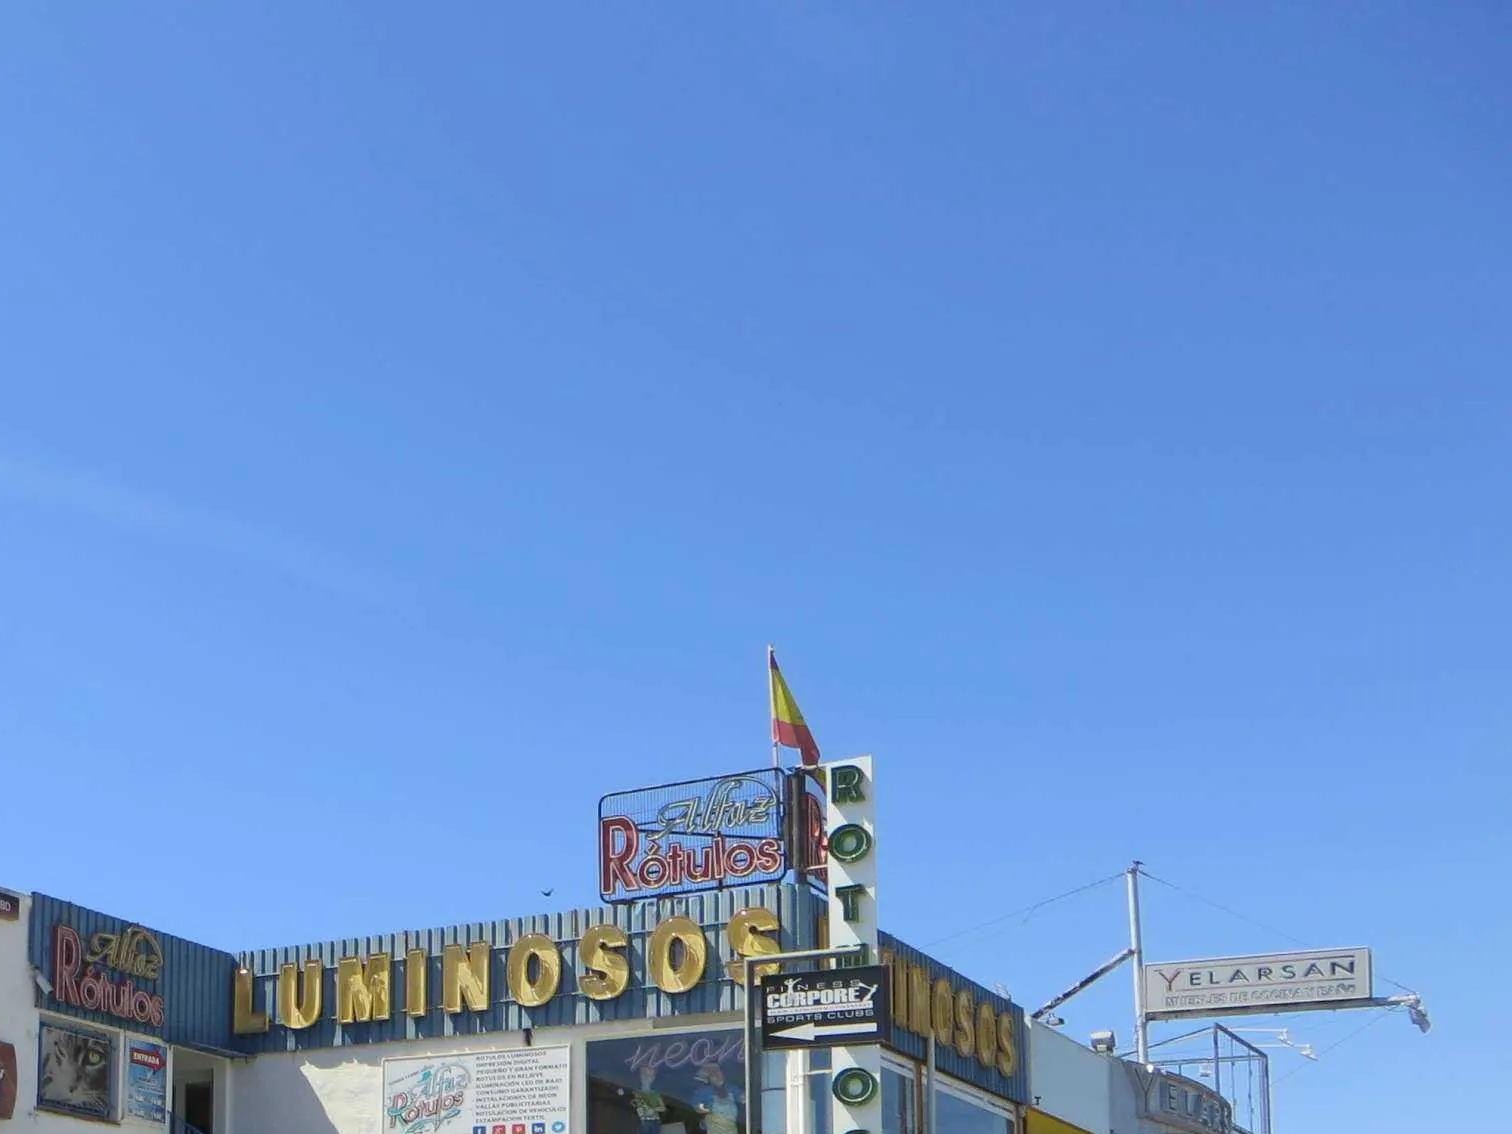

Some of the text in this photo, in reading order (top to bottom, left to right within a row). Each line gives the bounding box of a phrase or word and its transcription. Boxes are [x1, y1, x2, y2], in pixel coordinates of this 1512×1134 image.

[234, 907, 781, 1034] LUMINOSOS
[1154, 960, 1355, 992] YELARSAN
[767, 987, 861, 1008] CORPORE
